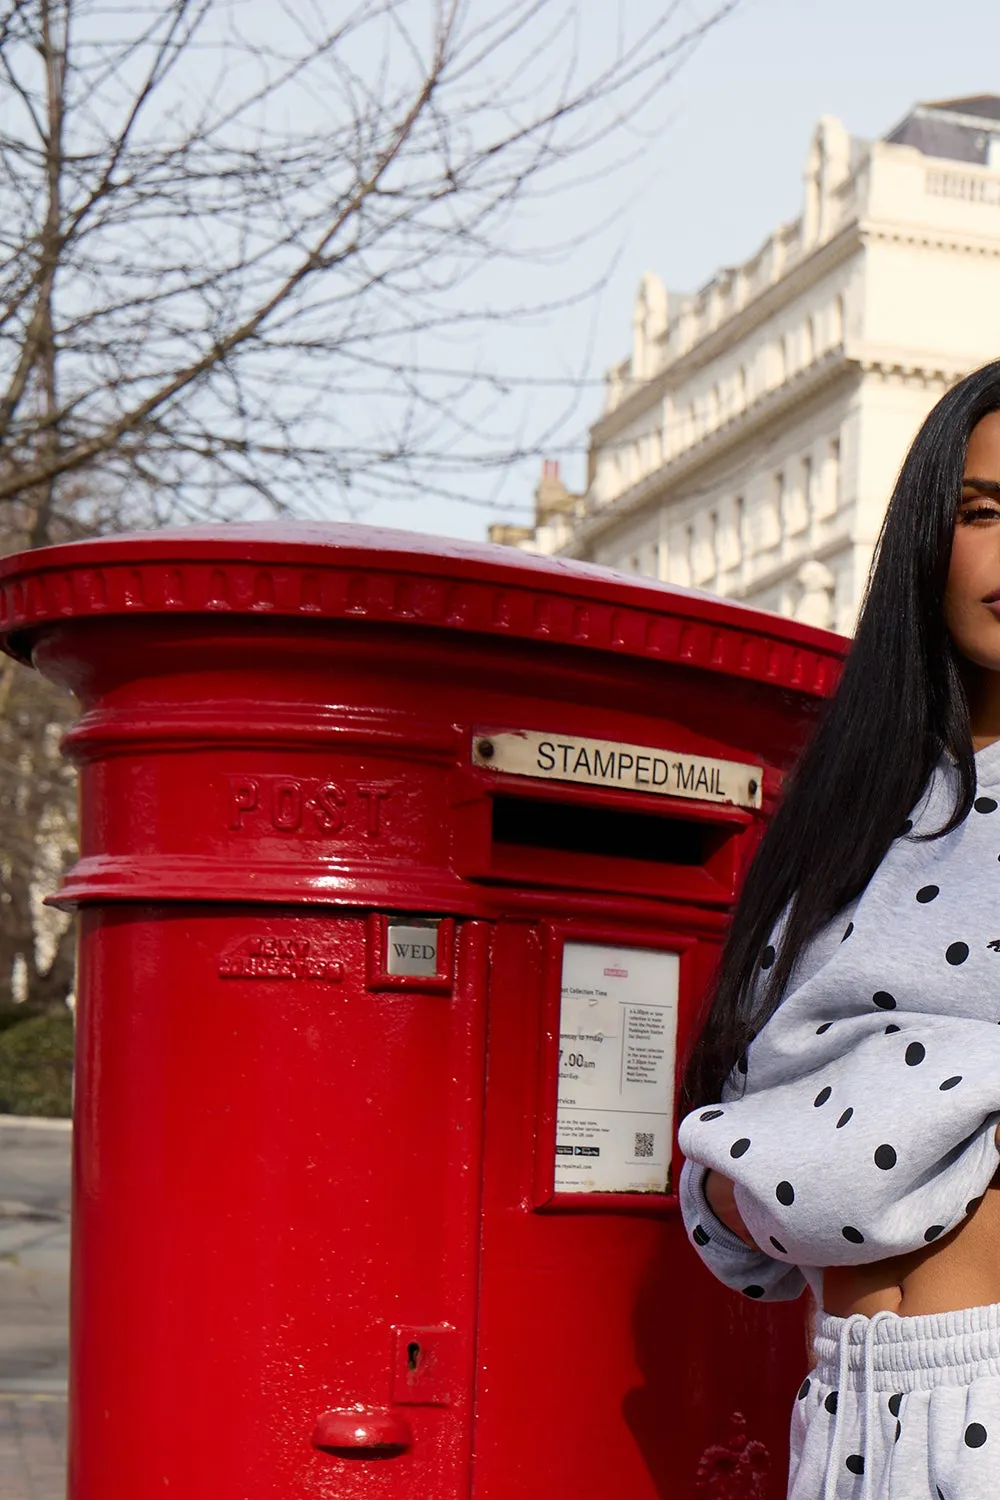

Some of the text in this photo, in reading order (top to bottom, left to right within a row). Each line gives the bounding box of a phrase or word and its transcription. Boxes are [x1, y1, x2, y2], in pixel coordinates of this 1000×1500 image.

[537, 741, 726, 796] STAMPED MAIL
[228, 779, 390, 837] POST
[393, 943, 436, 960] WED
[570, 988, 594, 996] Collection
[594, 989, 608, 997] Time
